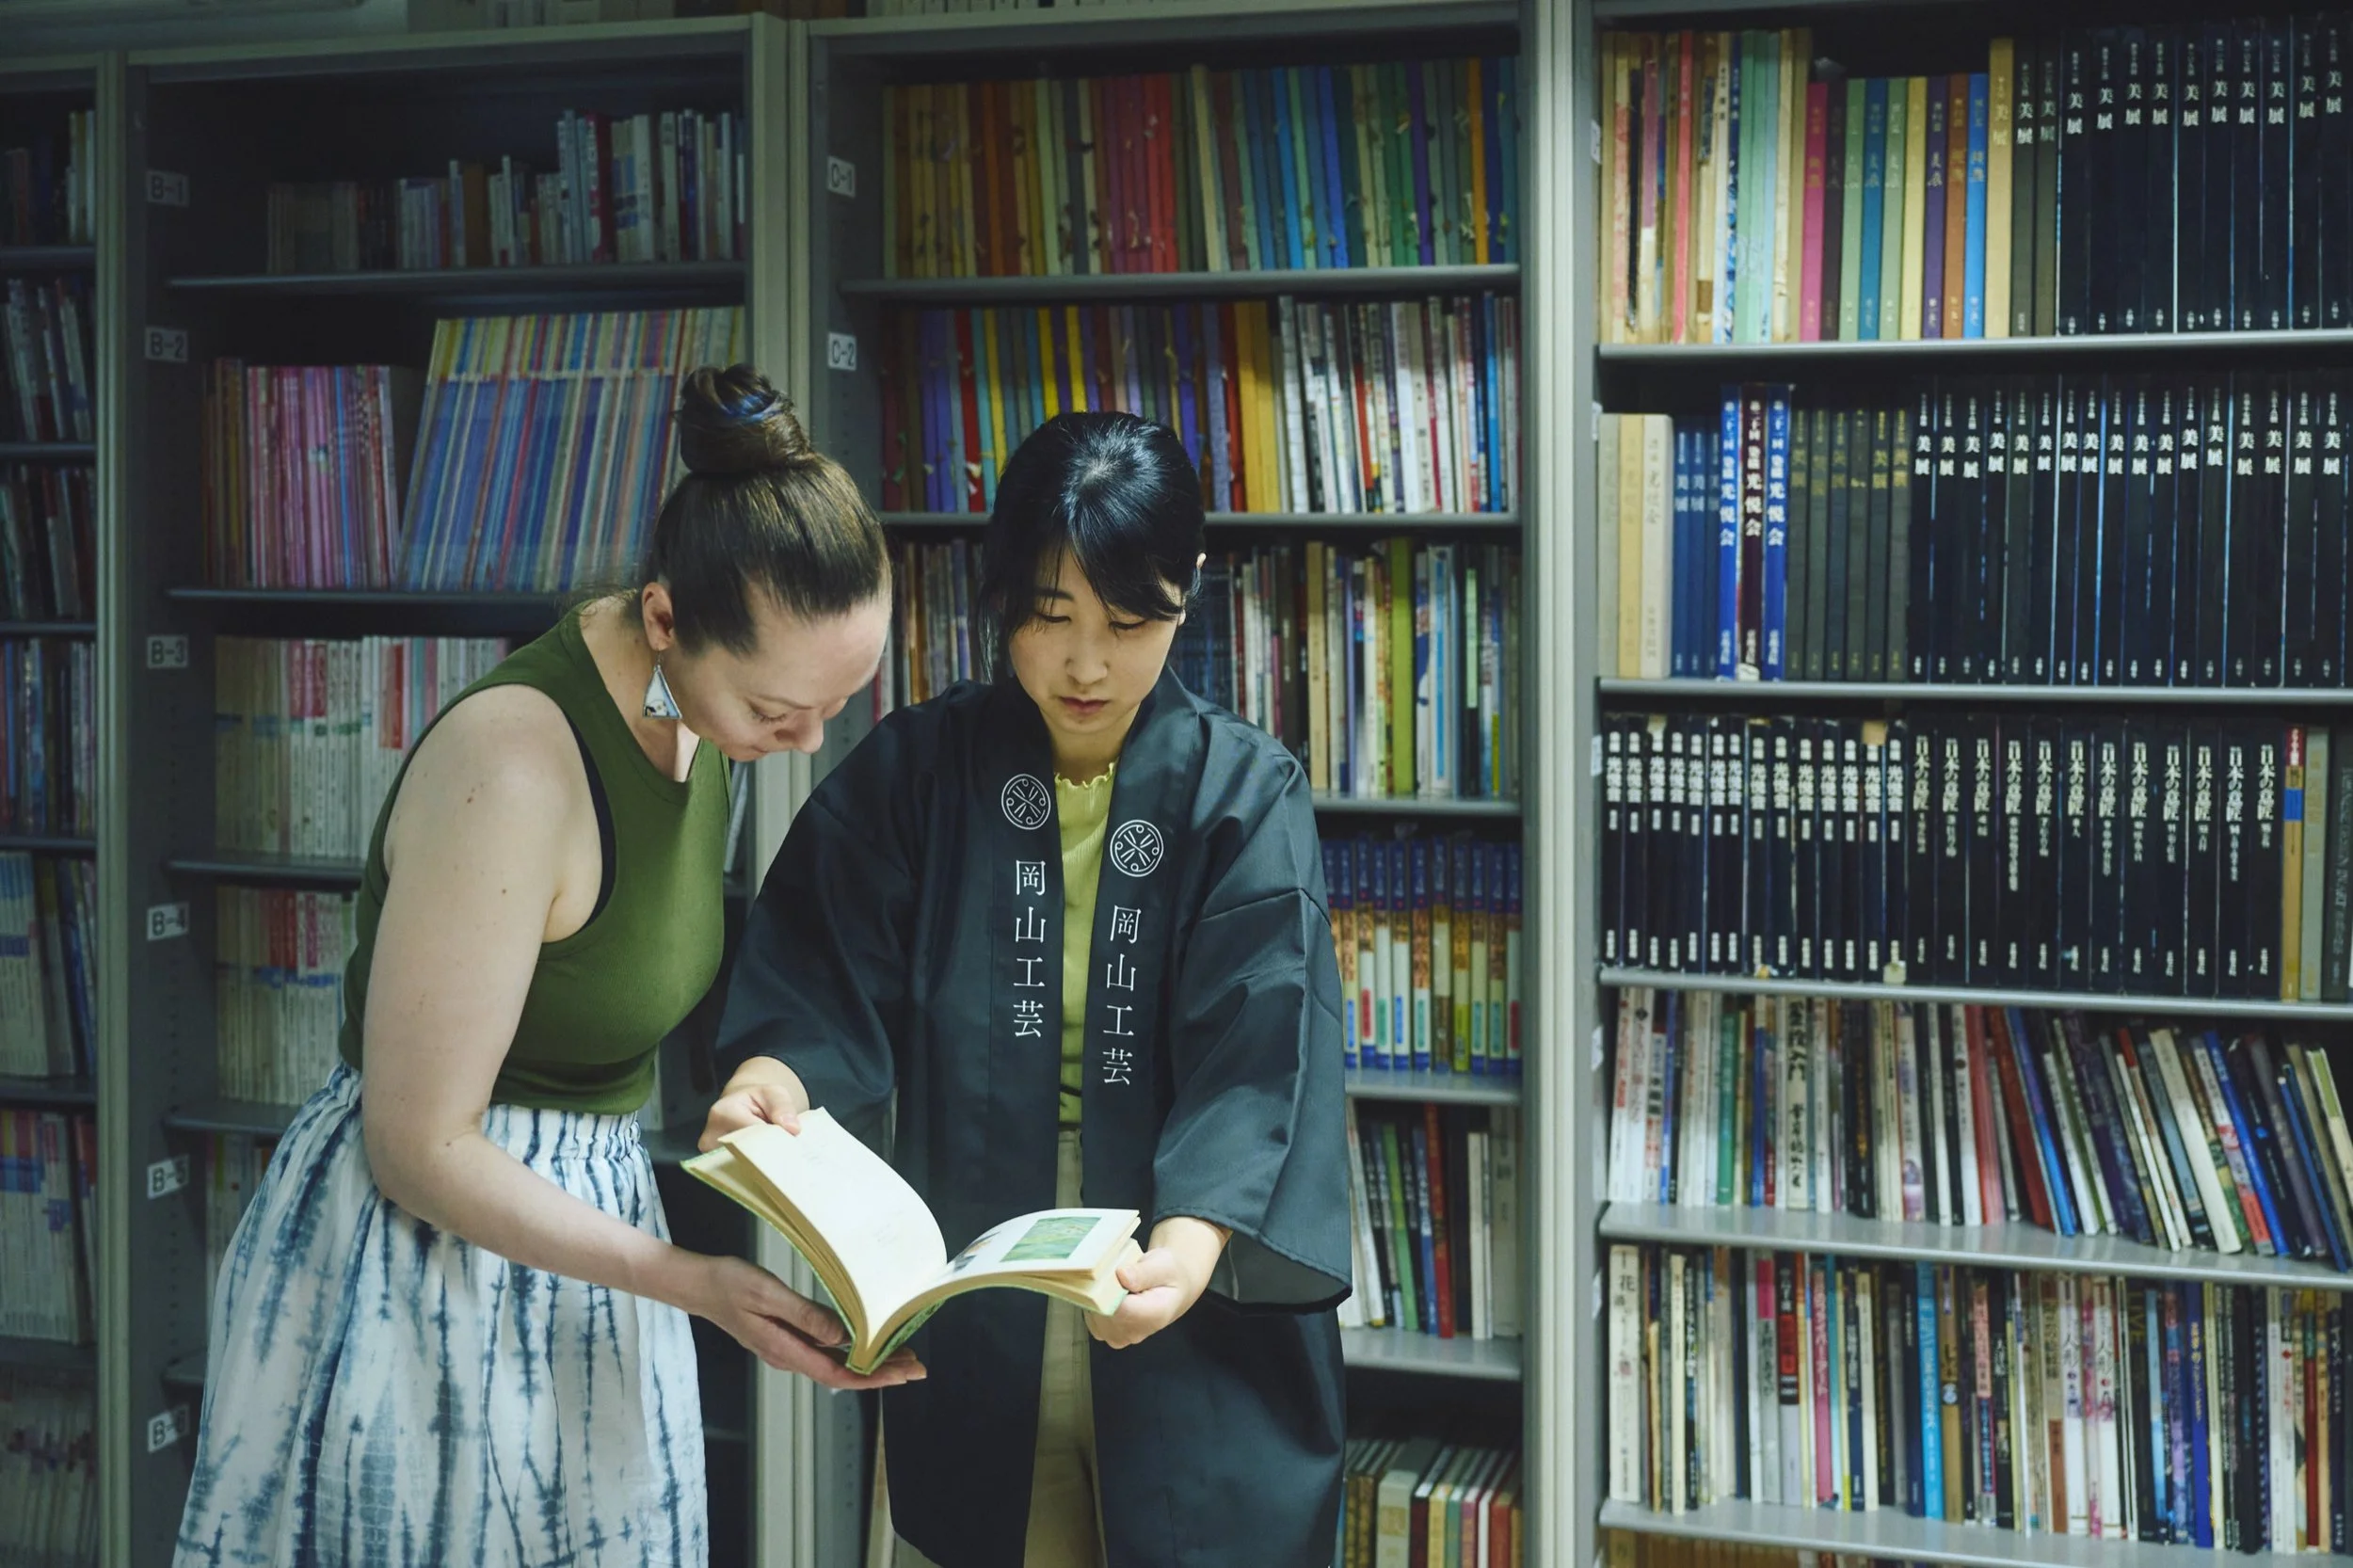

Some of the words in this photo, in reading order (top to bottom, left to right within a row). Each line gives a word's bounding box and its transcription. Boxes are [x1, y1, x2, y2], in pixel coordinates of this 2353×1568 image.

[152, 177, 184, 200] B-1
[831, 161, 853, 192] C-1
[151, 332, 184, 358] B-2
[831, 340, 855, 365] C-2
[152, 640, 185, 665] B-3
[1014, 860, 1046, 1037] 岡山工芸
[1103, 905, 1141, 1084] 岡山工芸
